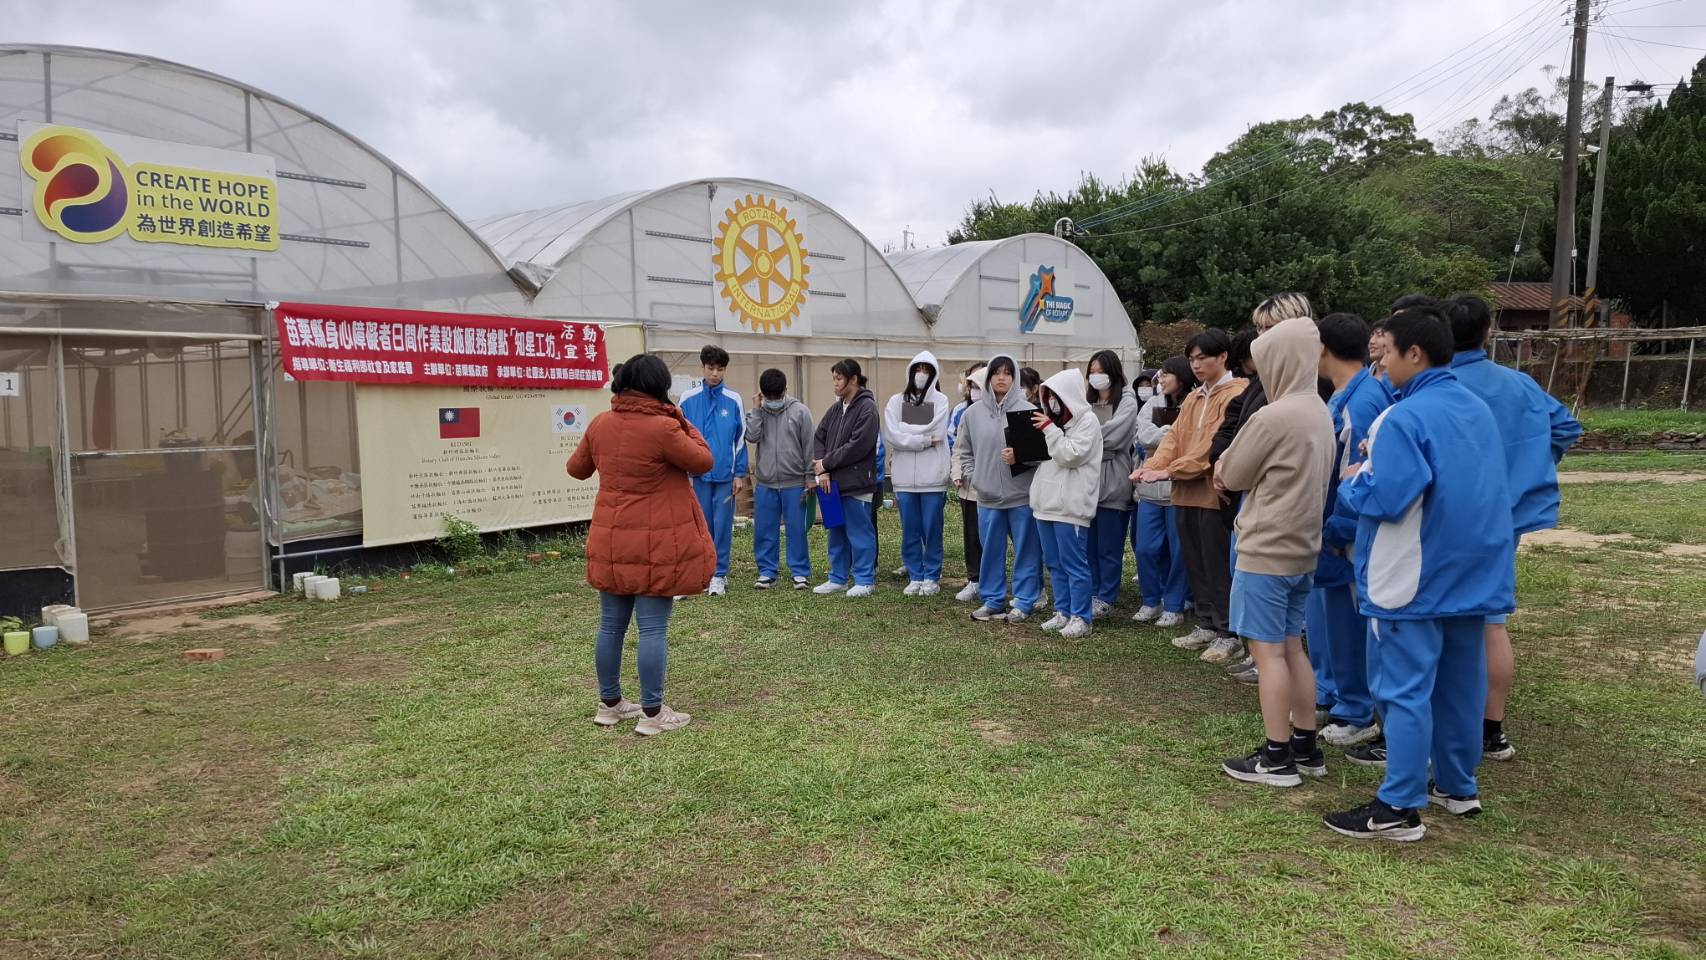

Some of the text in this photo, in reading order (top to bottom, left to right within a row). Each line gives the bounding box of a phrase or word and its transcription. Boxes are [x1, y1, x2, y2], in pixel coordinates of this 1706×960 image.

[136, 171, 269, 199] CREATE HOPE
[137, 190, 270, 217] in the WORLD
[743, 208, 783, 225] ROTARY
[136, 213, 272, 242] 為世界創造希望
[731, 284, 799, 318] INTERNATIONAL
[1046, 300, 1055, 309] THE
[561, 323, 597, 342] 活動
[564, 344, 598, 362] 宣導
[5, 378, 14, 390] 1
